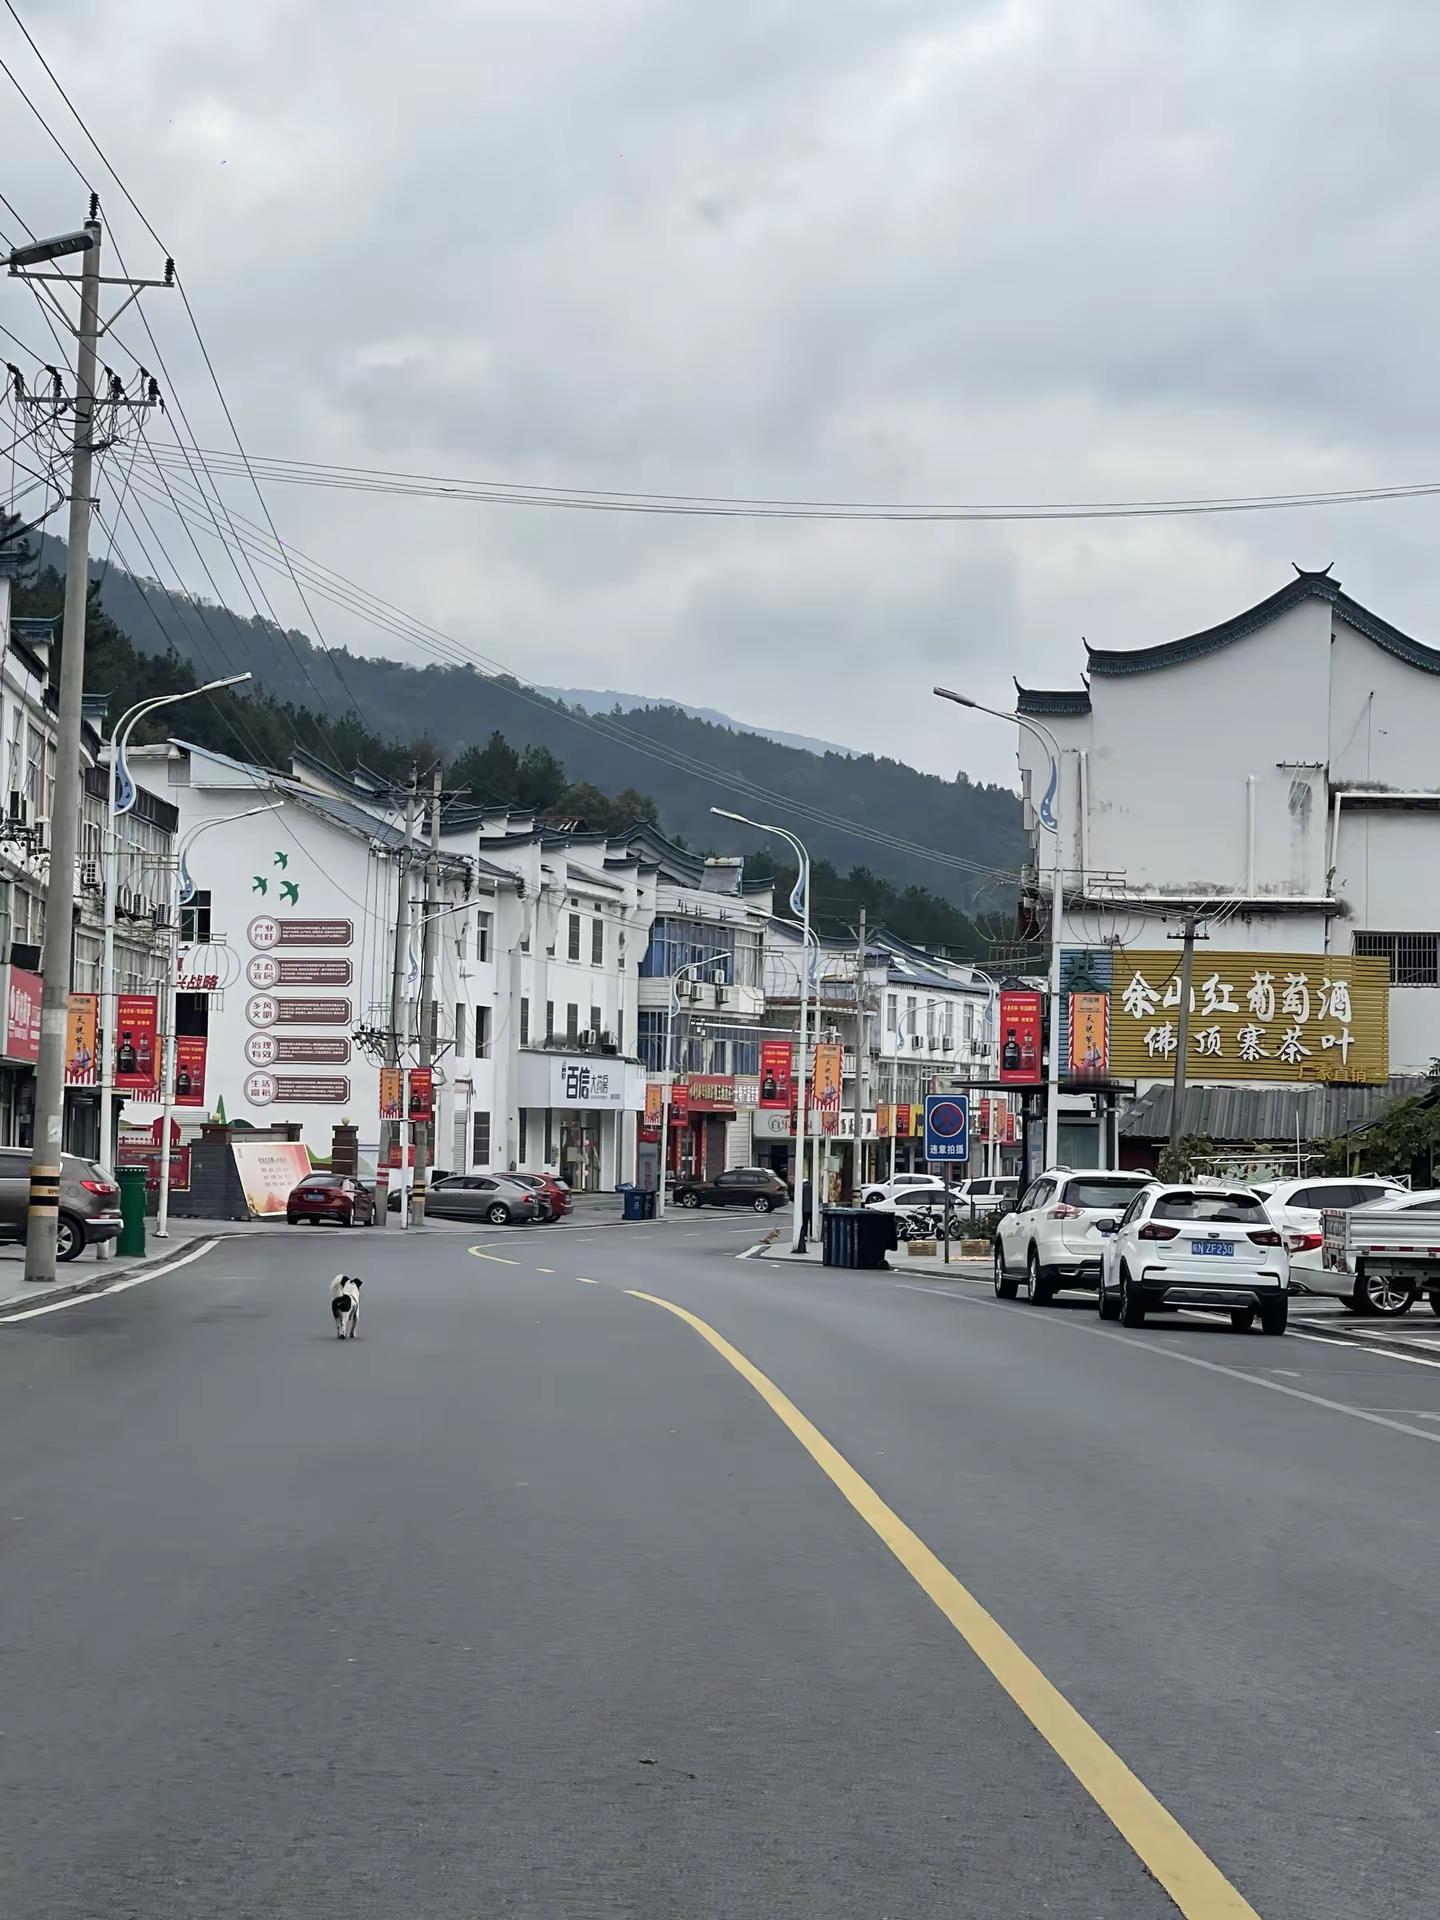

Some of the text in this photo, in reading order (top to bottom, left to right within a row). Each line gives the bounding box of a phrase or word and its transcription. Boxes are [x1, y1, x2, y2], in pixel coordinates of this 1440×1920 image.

[255, 924, 274, 932] 产业
[254, 933, 274, 941] 兴旺
[253, 962, 273, 971] 生态
[253, 972, 274, 980] 宜居
[253, 1002, 272, 1010] 乡风
[253, 1011, 272, 1019] 文明
[252, 1041, 272, 1049] 治理
[1143, 1021, 1355, 1066] 佛顶寨茶叶
[252, 1050, 272, 1058] 有效
[1298, 1063, 1367, 1083] 厂家直销
[251, 1079, 271, 1088] 生活
[250, 1088, 271, 1097] 富裕
[929, 1144, 964, 1155] 违章拍摄
